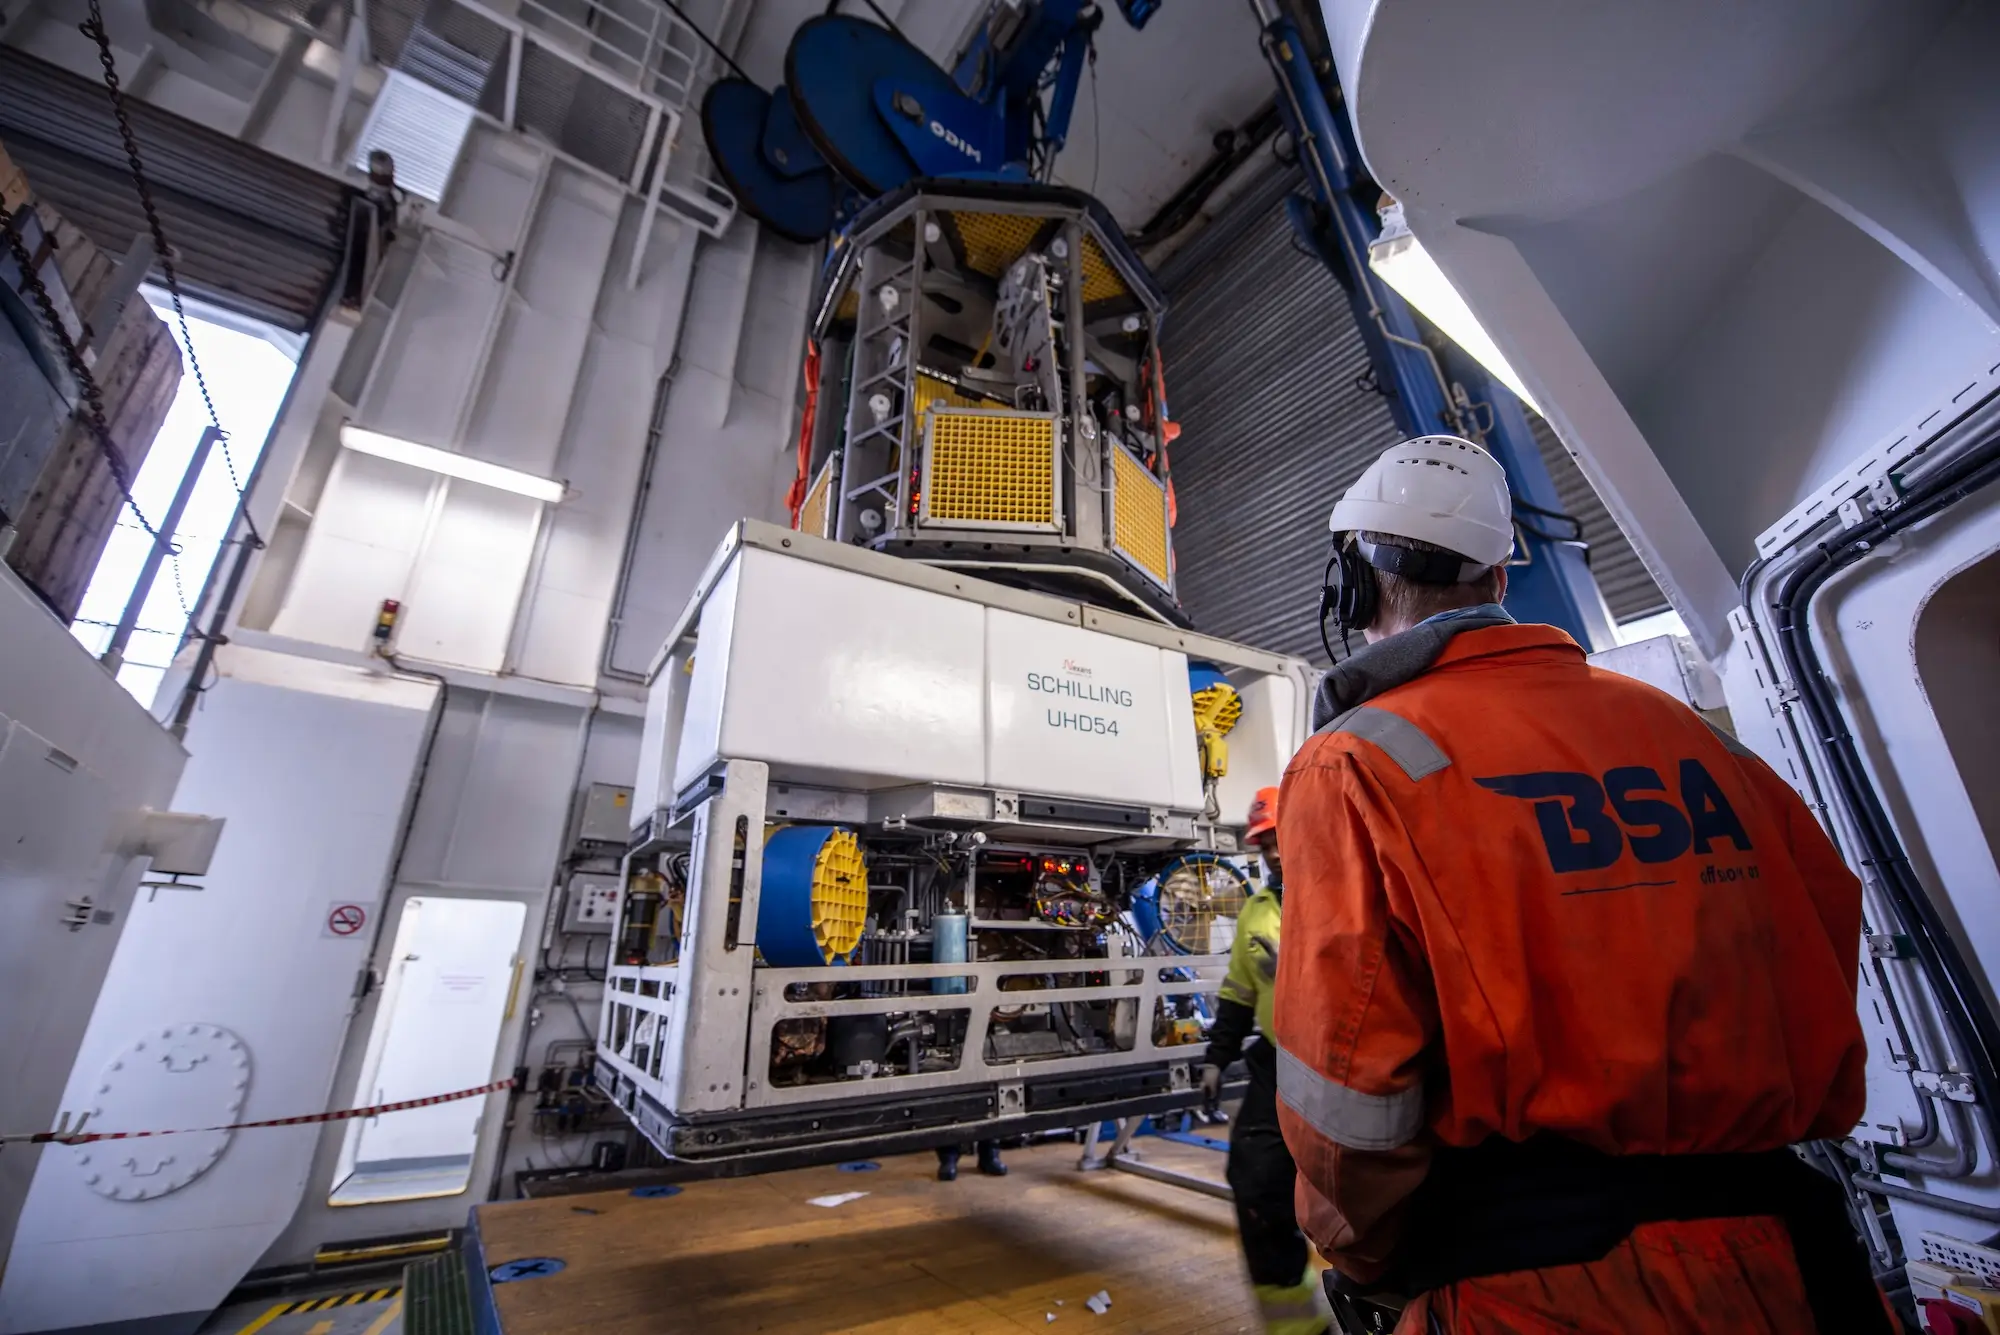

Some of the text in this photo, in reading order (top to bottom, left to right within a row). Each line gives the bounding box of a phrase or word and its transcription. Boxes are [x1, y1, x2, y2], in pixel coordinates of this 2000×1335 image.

[930, 120, 981, 164] ODIM
[1062, 659, 1092, 675] Nexans
[1027, 672, 1133, 707] SCHILLING
[1047, 708, 1119, 737] UHD54
[1472, 758, 1753, 874] BSA
